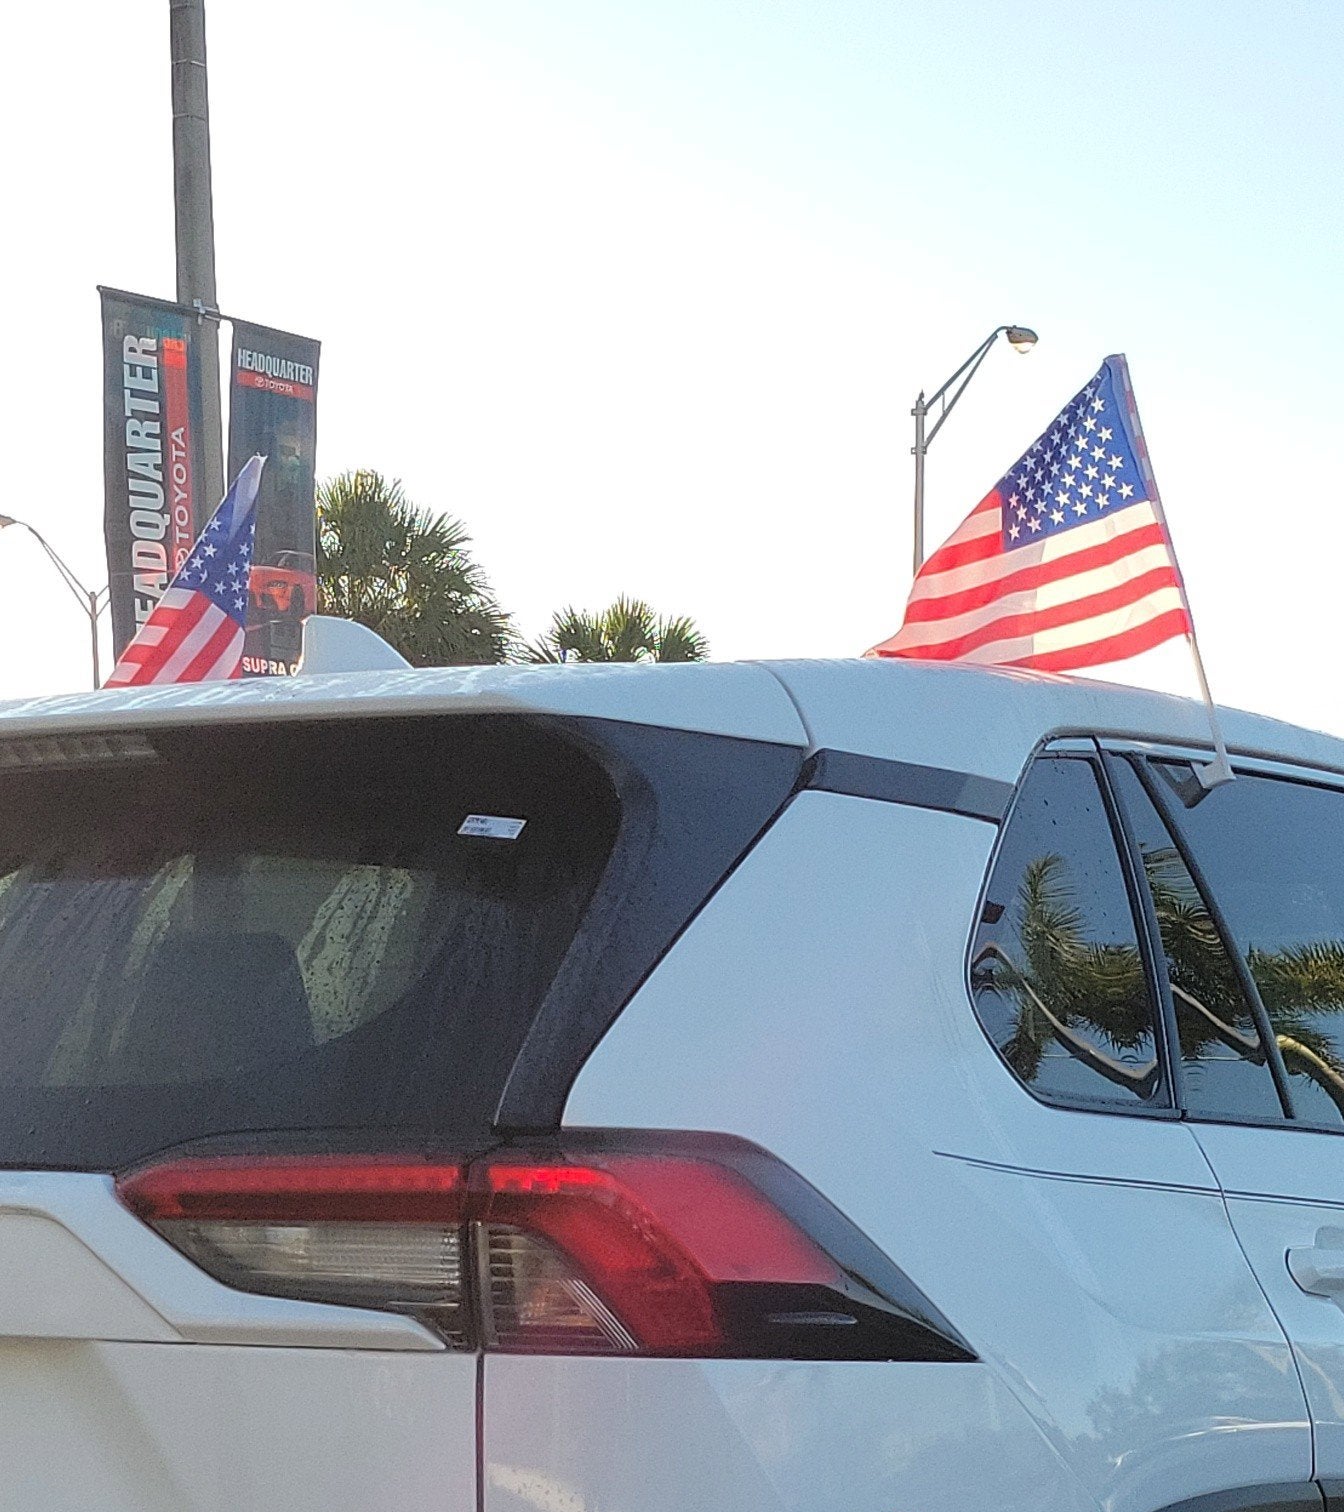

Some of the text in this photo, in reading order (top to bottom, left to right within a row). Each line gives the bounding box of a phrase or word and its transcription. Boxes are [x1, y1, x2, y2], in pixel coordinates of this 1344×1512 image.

[238, 347, 313, 386] HEADQUARTER
[265, 379, 294, 393] TOYOTA
[123, 335, 172, 634] EADQUARTER
[170, 427, 191, 544] TOYOTA
[242, 656, 287, 676] SUPRA
